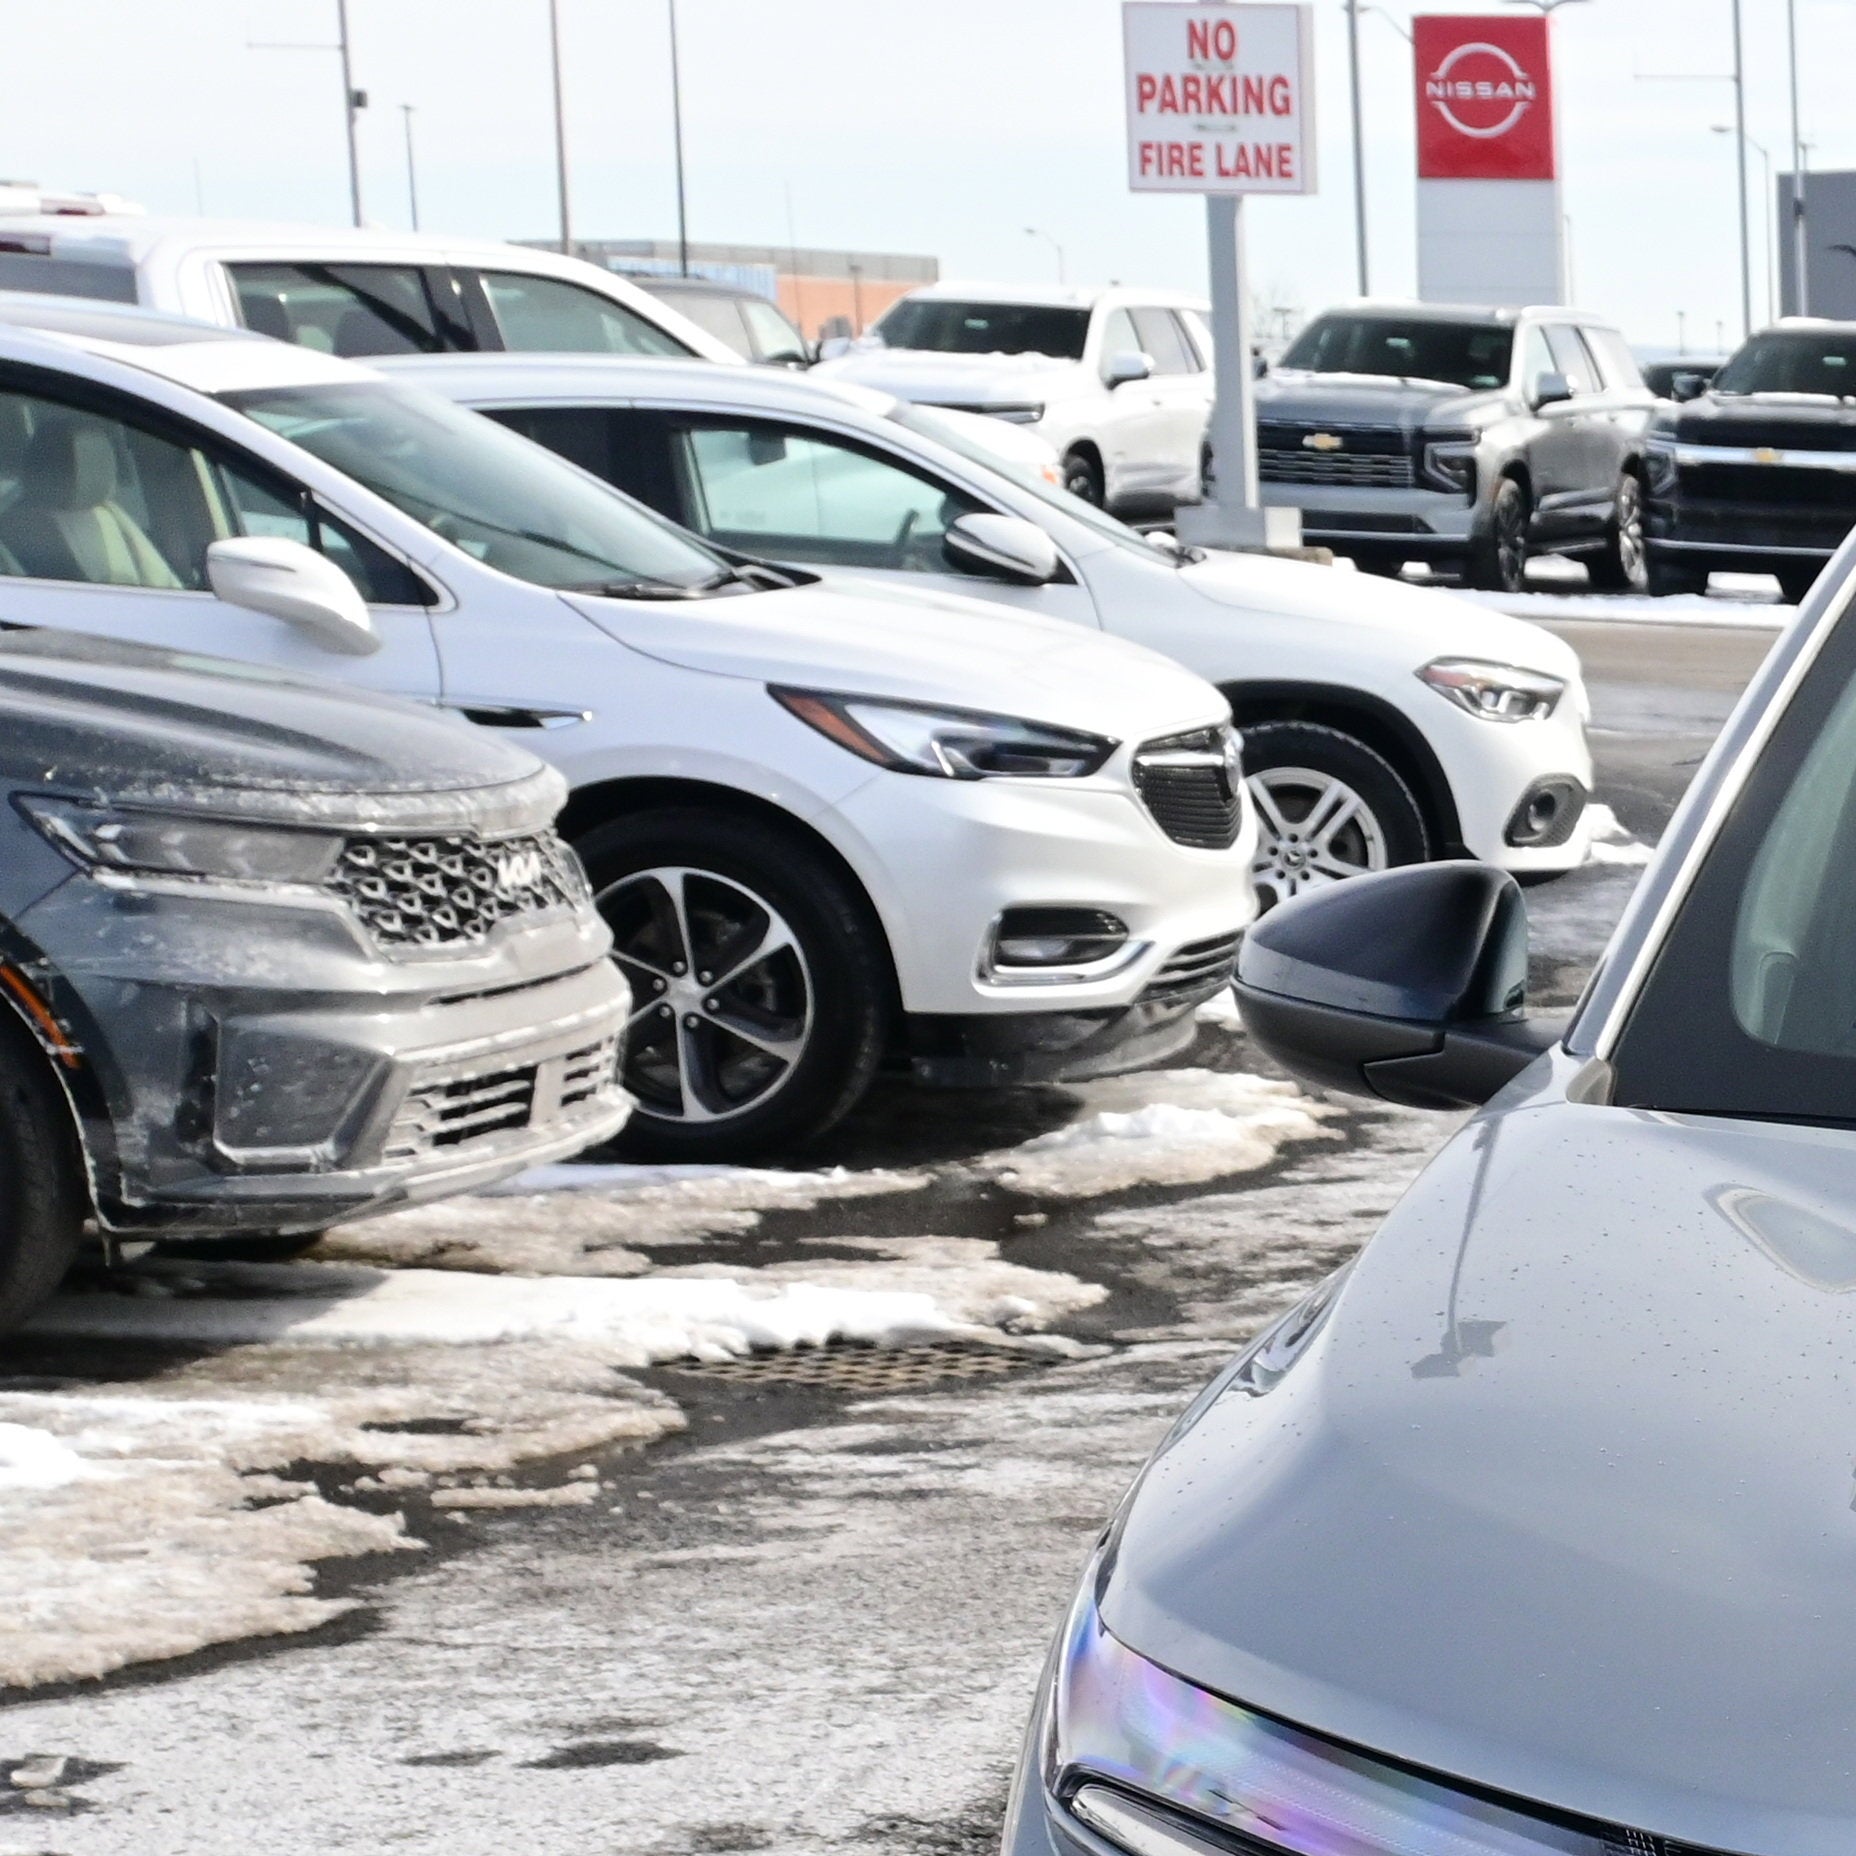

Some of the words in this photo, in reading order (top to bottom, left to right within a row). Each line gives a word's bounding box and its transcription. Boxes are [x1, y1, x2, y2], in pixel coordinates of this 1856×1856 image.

[1187, 19, 1236, 61] NO
[1137, 74, 1291, 115] PARKING
[1426, 81, 1536, 99] NISSAN
[1138, 141, 1204, 177] FIRE
[1215, 142, 1293, 179] LANE
